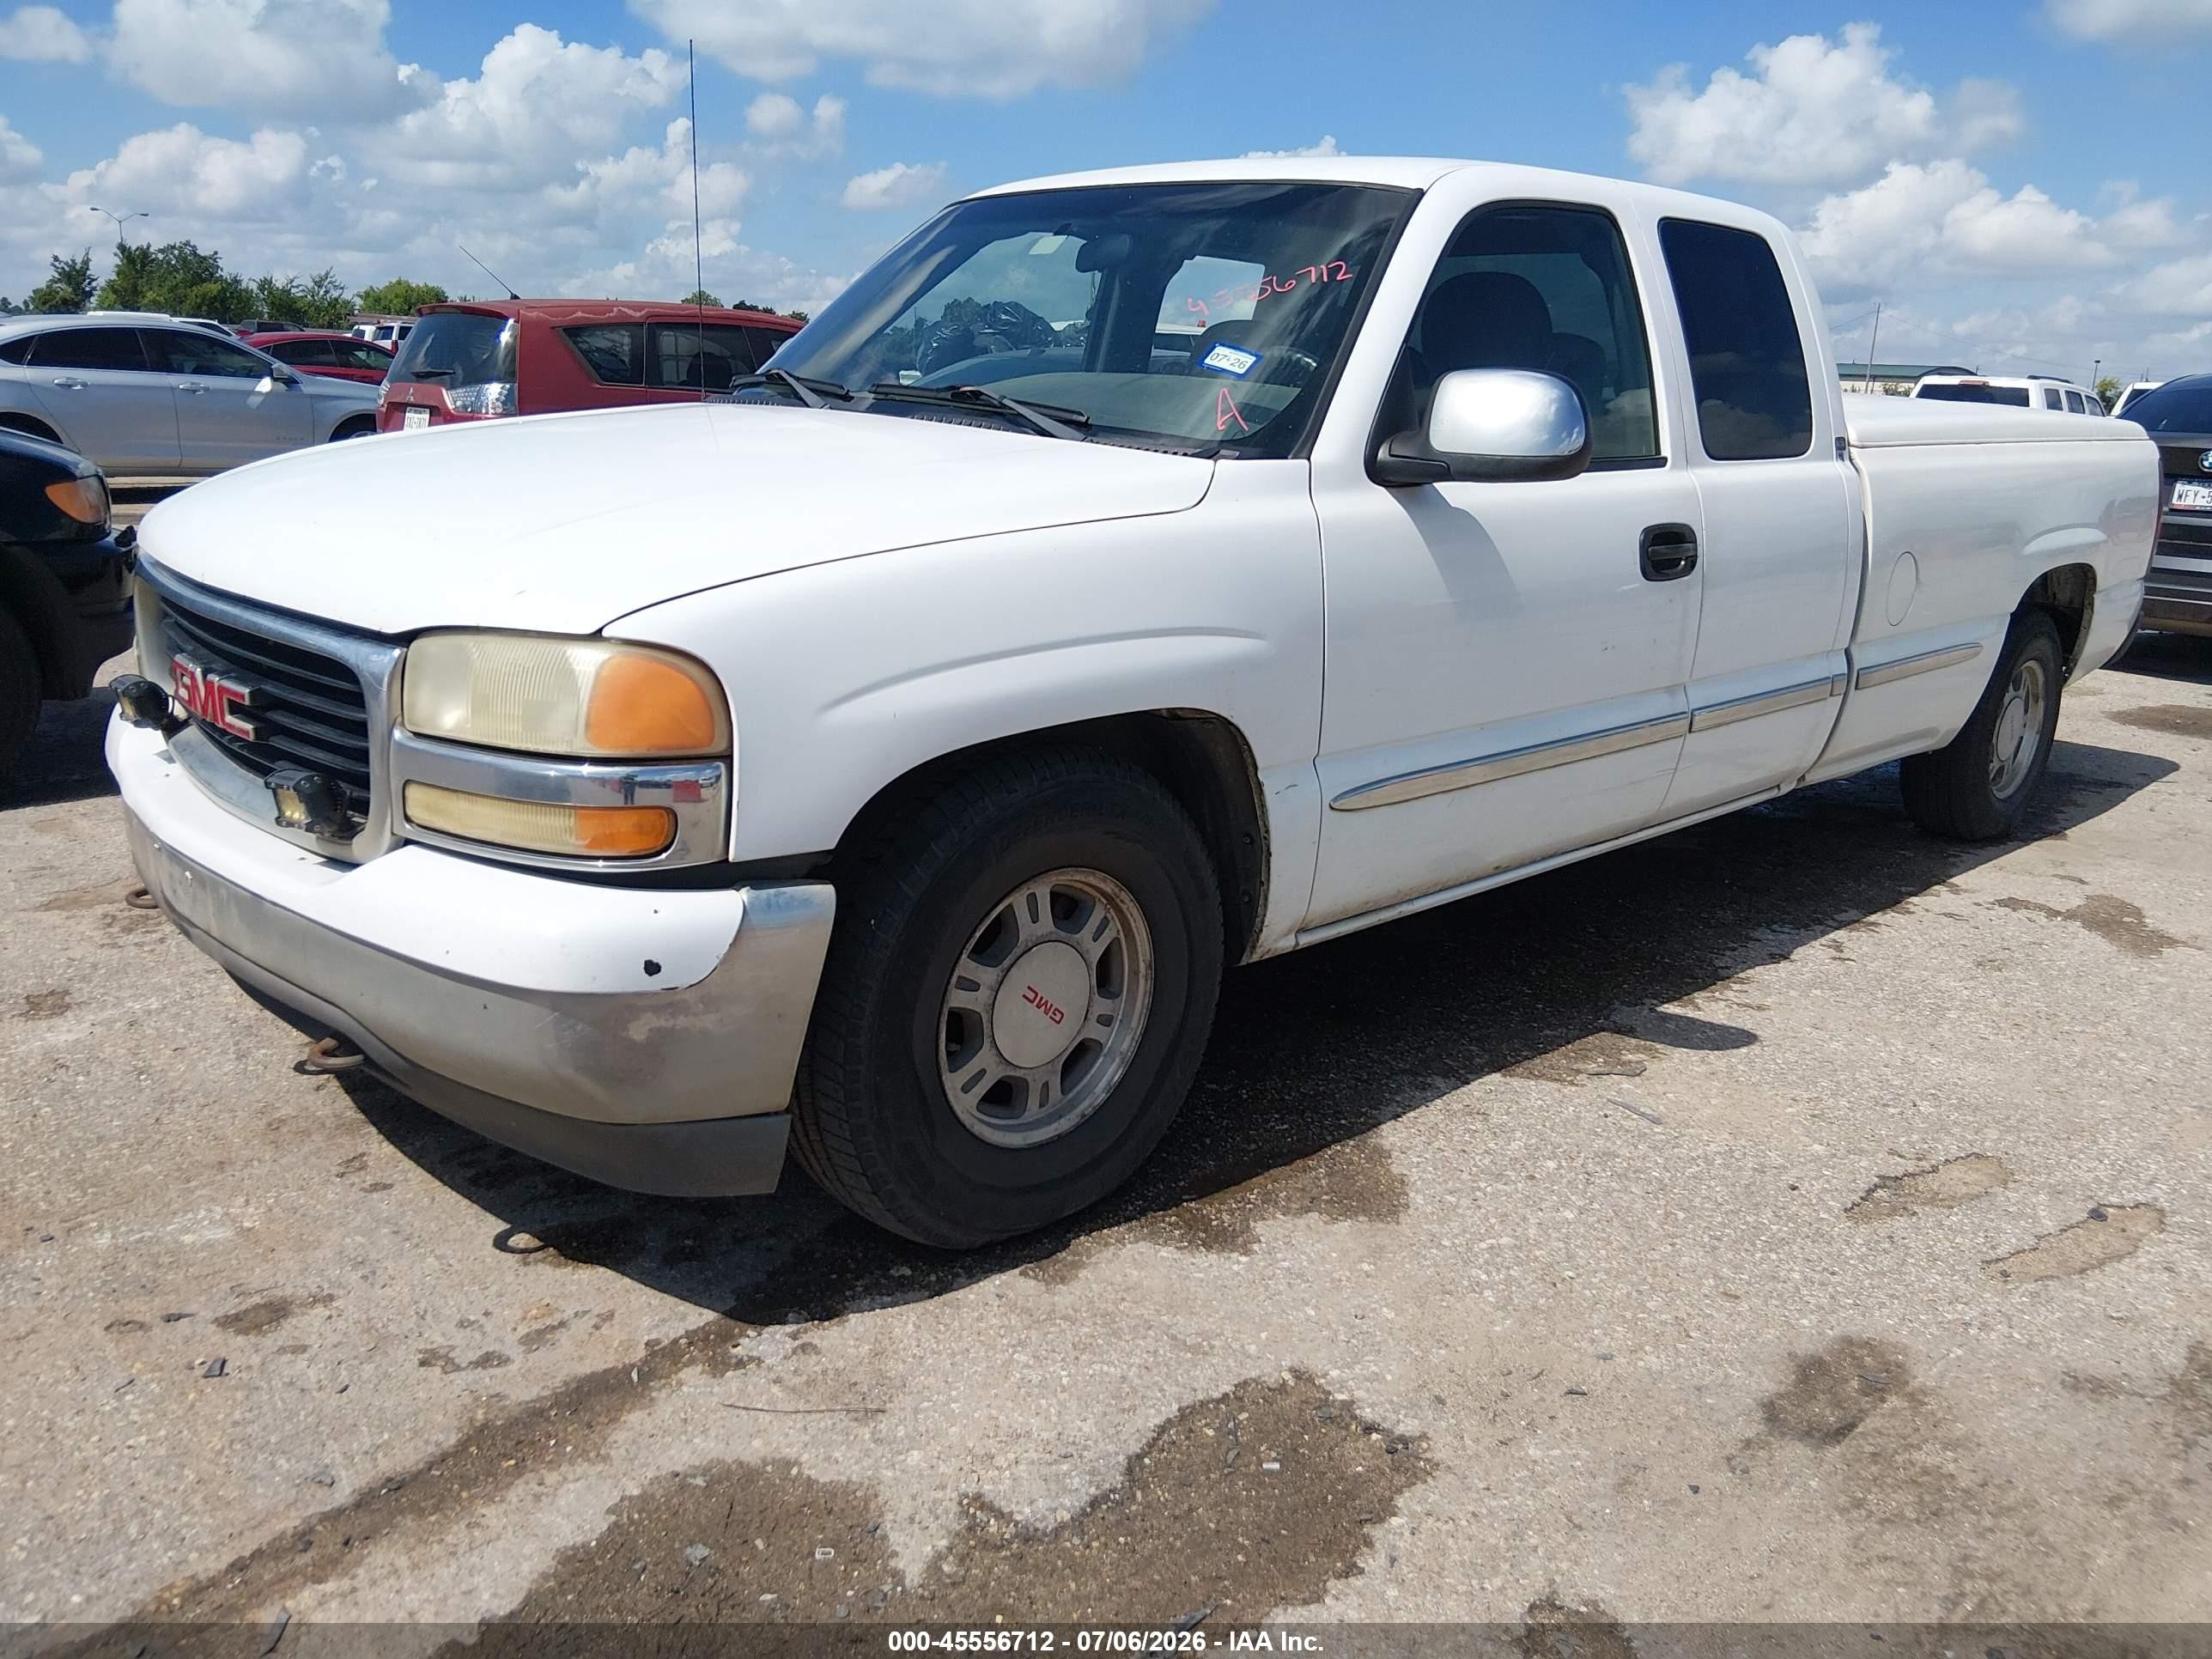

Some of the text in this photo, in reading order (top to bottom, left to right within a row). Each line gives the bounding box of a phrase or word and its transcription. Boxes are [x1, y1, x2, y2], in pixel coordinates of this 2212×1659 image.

[1210, 352, 1228, 363] 07
[1229, 357, 1249, 370] 26
[1216, 387, 1249, 431] A
[172, 653, 258, 742] GMC
[1022, 985, 1065, 1025] GMC
